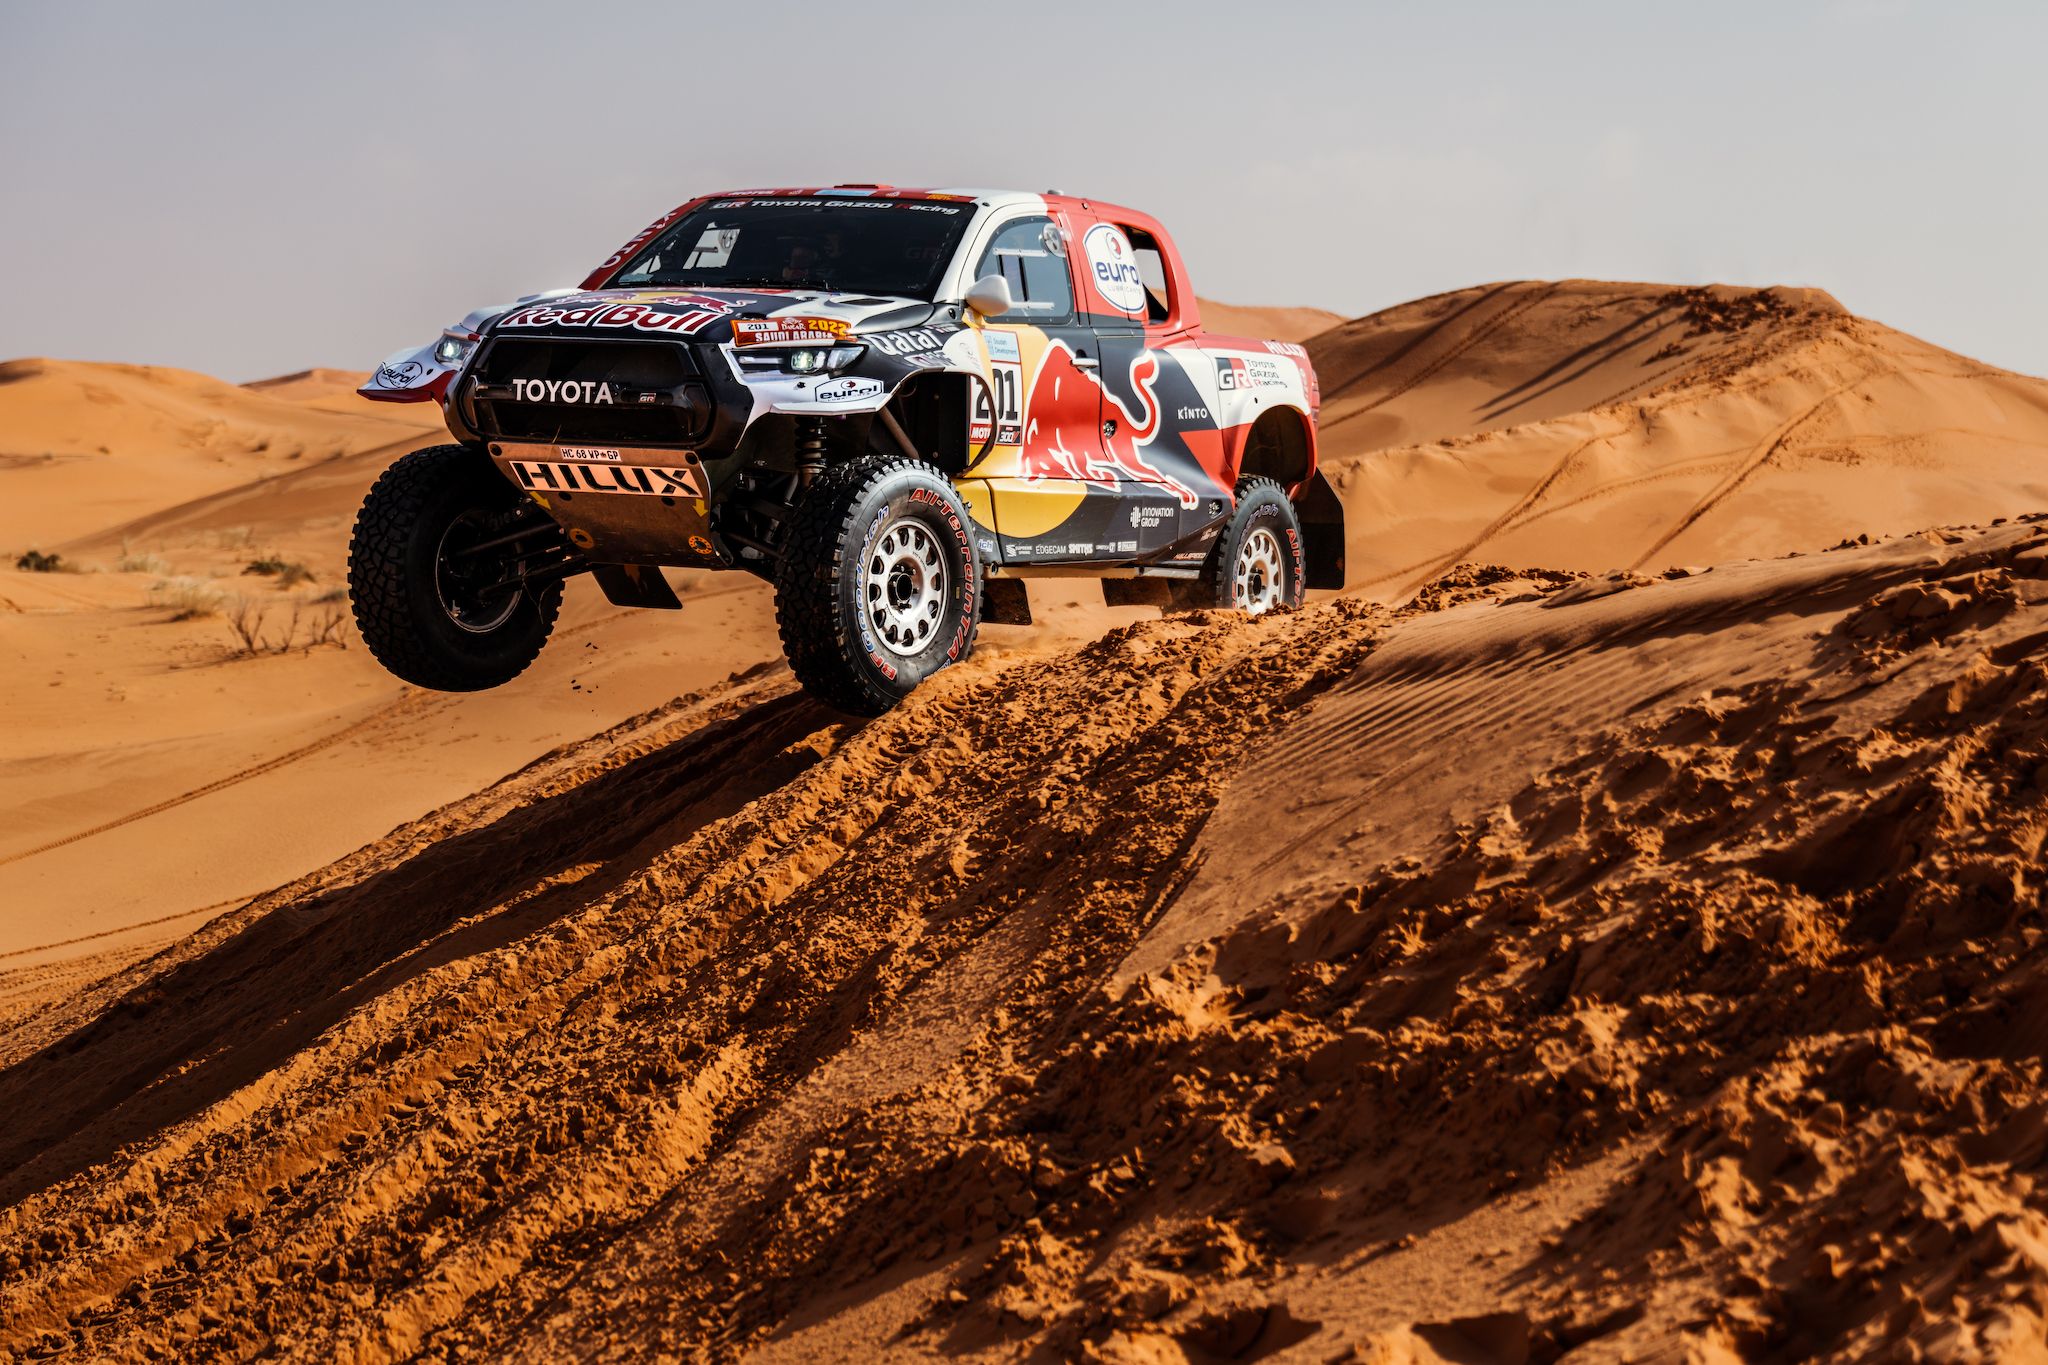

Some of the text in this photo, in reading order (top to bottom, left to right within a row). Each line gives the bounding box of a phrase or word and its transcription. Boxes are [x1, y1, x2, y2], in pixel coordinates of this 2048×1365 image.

[713, 200, 960, 215] GR TOYOTA GAZOO Racing
[497, 304, 728, 335] Red Bull
[747, 323, 769, 331] 201
[807, 320, 848, 336] 2022
[755, 331, 834, 342] SAUDI ARABIA
[863, 327, 944, 356] Qatar
[1262, 341, 1305, 359] HILUX
[1246, 359, 1276, 369] TOYOTA
[1219, 369, 1252, 388] GR
[1250, 369, 1280, 379] GAZOO
[1255, 380, 1288, 388] Racing
[512, 378, 614, 405] TOYOTA
[638, 393, 657, 403] GR
[820, 385, 877, 399] eurol
[561, 448, 619, 460] HC 68 WP GP
[512, 462, 701, 496] HILUX
[1142, 507, 1174, 518] INNOVATION
[1141, 517, 1160, 528] GROUP
[908, 487, 976, 615] All-Terrain
[1035, 544, 1067, 555] EDGECAM
[1068, 543, 1094, 556] SMITHS
[855, 504, 898, 681] BFGoodrich
